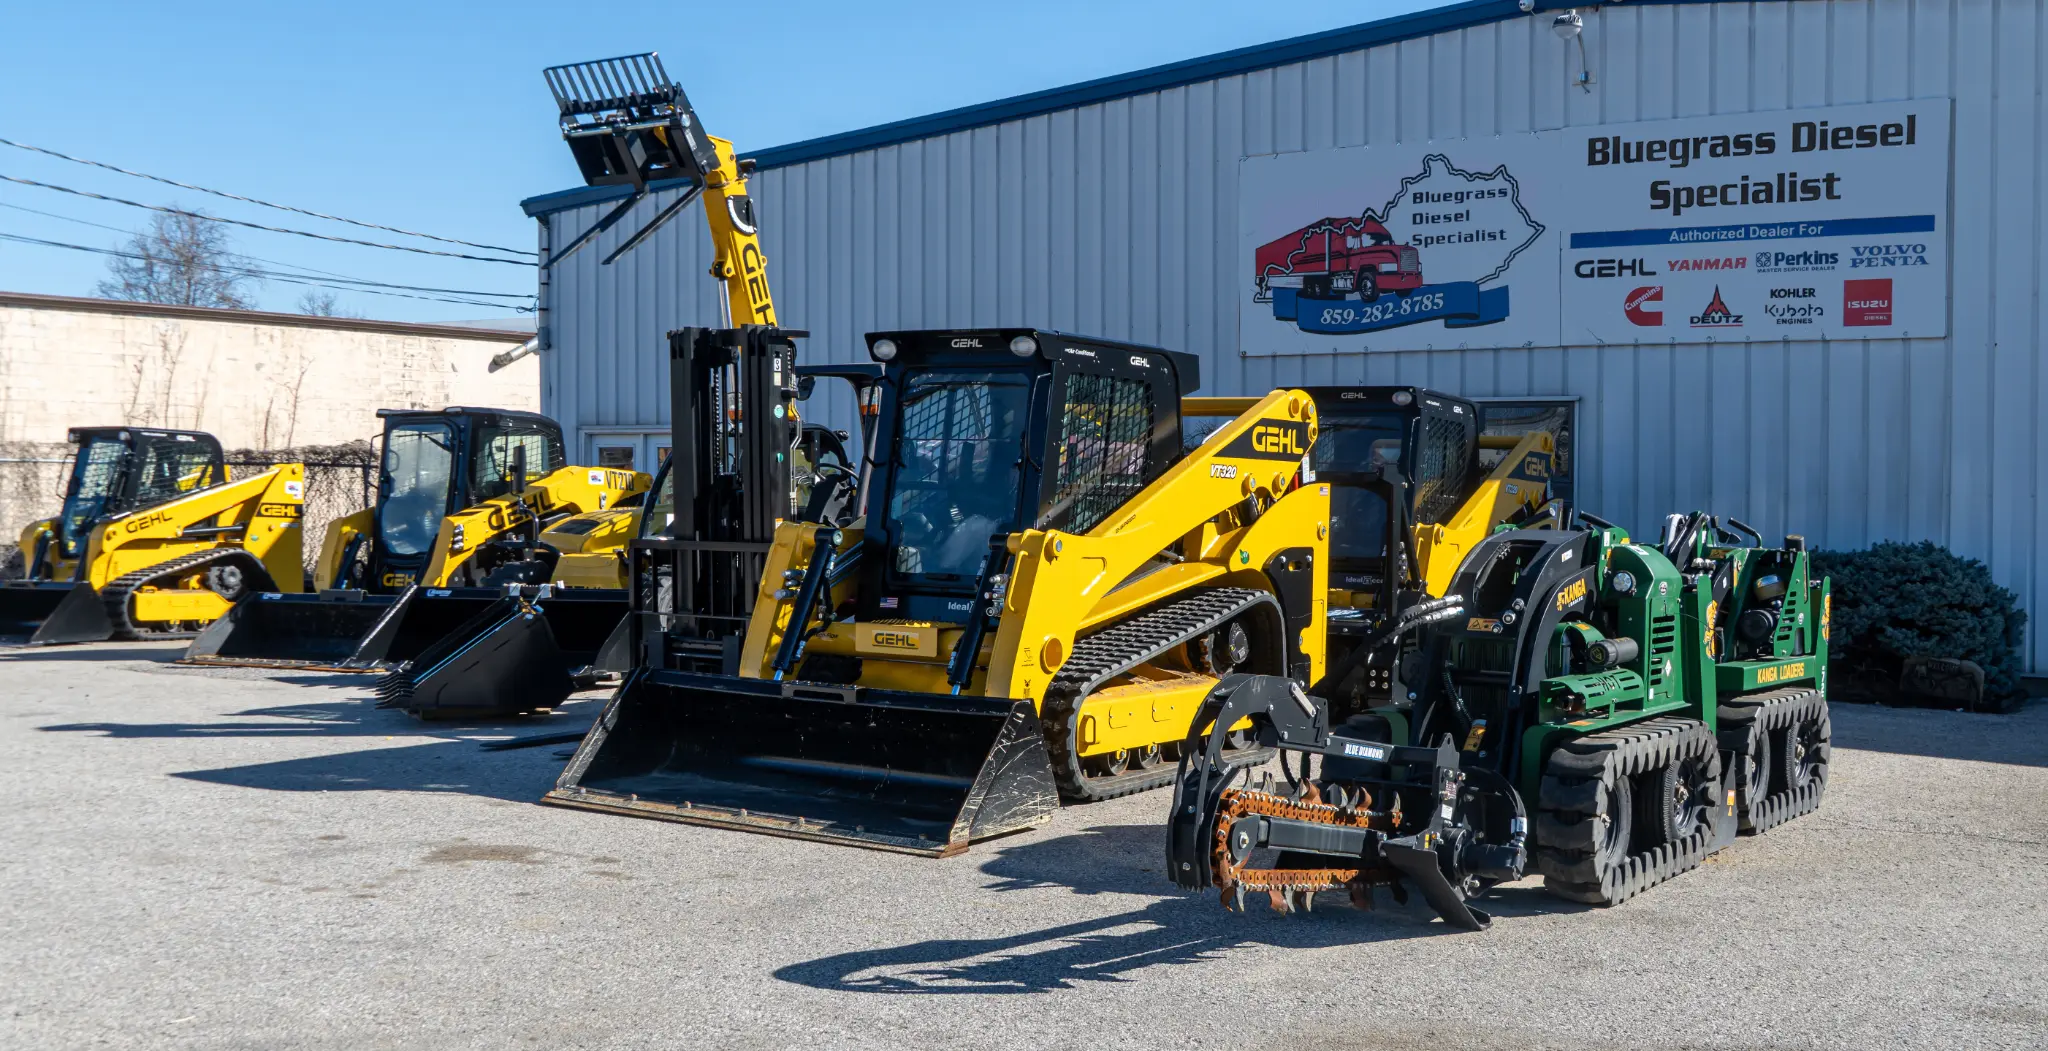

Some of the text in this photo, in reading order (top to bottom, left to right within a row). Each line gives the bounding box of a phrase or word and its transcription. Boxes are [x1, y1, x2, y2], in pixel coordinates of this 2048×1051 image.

[1587, 114, 1916, 168] Bluegrass Diesel
[1412, 188, 1508, 204] Bluegrass
[1649, 172, 1841, 216] Specialist
[1412, 209, 1470, 225] Diesel
[1412, 229, 1507, 248] Specialist
[1669, 224, 1824, 242] Authorized Dealer For
[1851, 243, 1927, 257] VOLVO
[1667, 256, 1747, 272] YANMAR
[1774, 250, 1839, 267] Perkins
[1849, 255, 1929, 268] PENTA
[1574, 258, 1657, 278] GEHL
[742, 243, 776, 327] GEH
[1624, 285, 1661, 311] Cummins
[1770, 288, 1816, 299] KOHLER
[1320, 293, 1444, 325] 859-282-8785
[1764, 303, 1824, 317] Kubota
[1847, 300, 1888, 309] ISUZU
[1690, 315, 1743, 324] DEUTZ
[951, 338, 983, 348] GEHL
[1130, 356, 1150, 368] GEHL
[1252, 425, 1304, 455] GEHL
[1210, 463, 1237, 479] VT320
[1525, 456, 1549, 478] GEHL
[604, 470, 635, 492] VT210
[260, 504, 300, 517] GEHL
[125, 511, 173, 534] GEHL
[383, 573, 416, 587] GEH
[1563, 578, 1586, 605] KANGA
[948, 600, 975, 613] Ideal
[874, 632, 916, 647] GEHL
[1757, 662, 1805, 684] KANGA LOADERS
[1344, 743, 1384, 759] BLUE DIAMOND
